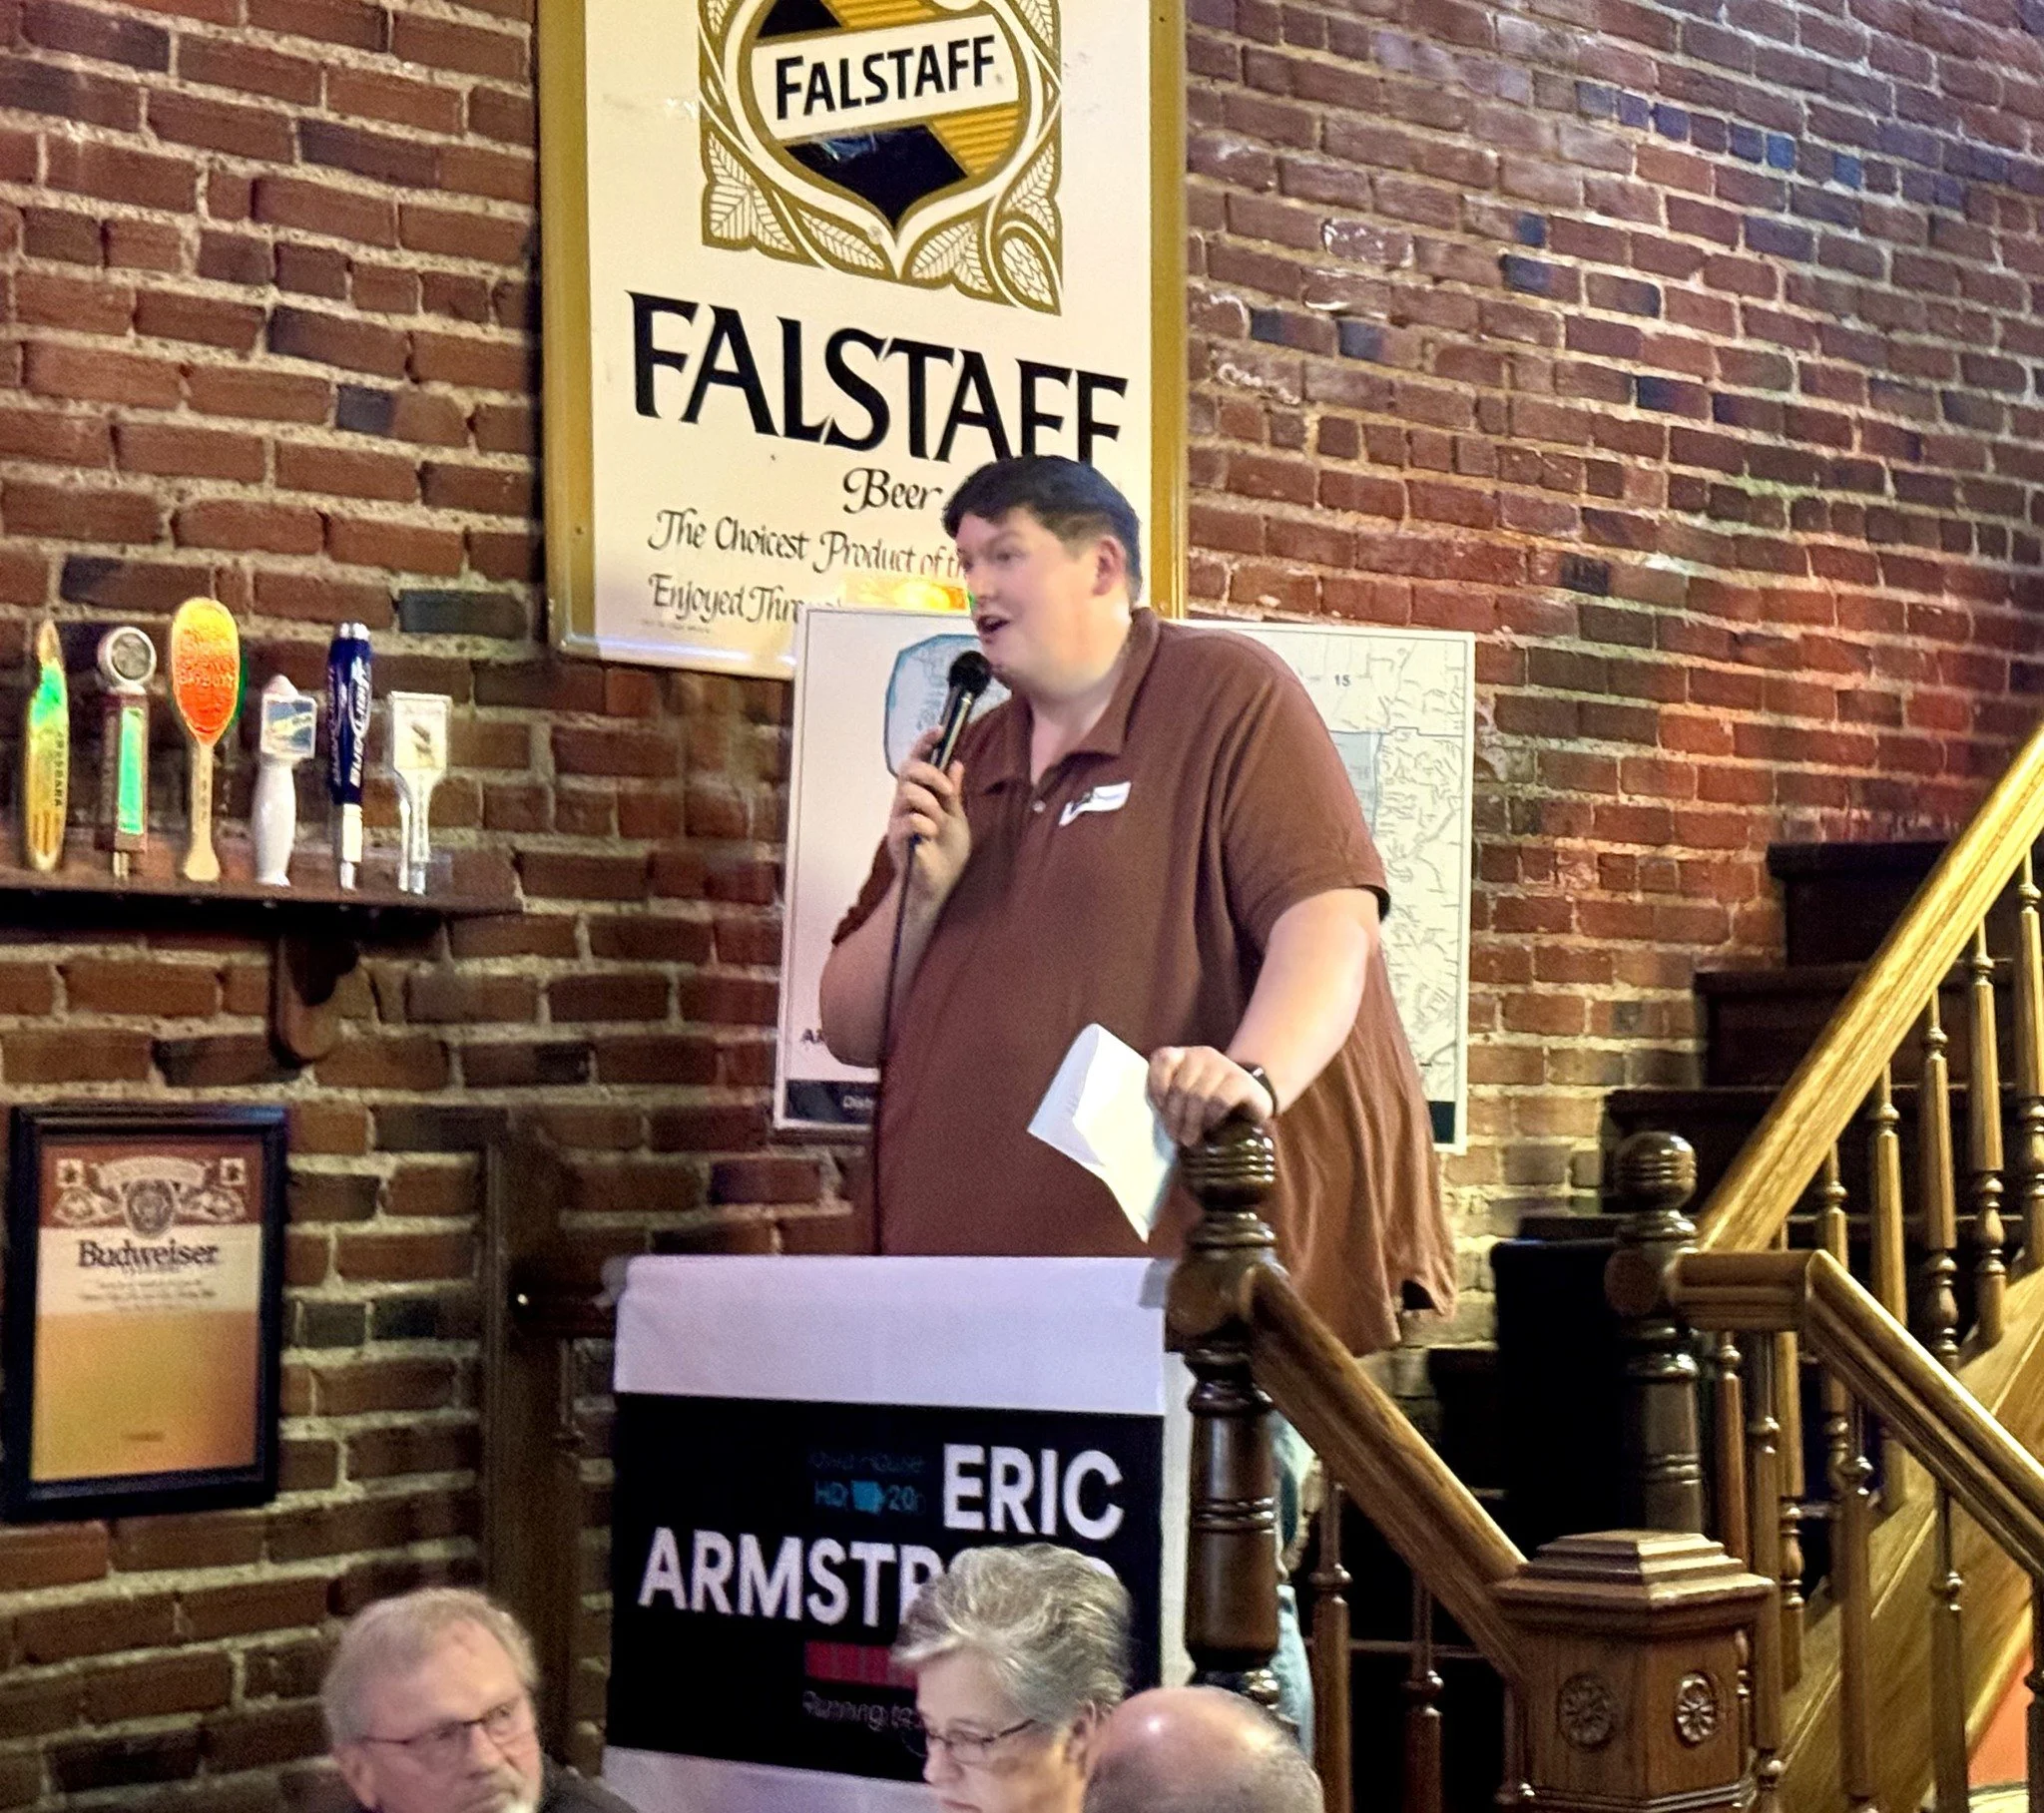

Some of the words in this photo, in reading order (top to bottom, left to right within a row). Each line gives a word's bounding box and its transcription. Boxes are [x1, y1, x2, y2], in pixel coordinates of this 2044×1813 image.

[775, 35, 995, 120] FALSTAFF
[626, 290, 1129, 466] FALSTAFF
[842, 467, 943, 514] Beer
[647, 508, 707, 550] The
[715, 516, 809, 560] Choicest
[812, 530, 916, 574] Product
[920, 546, 947, 577] of
[648, 573, 746, 624] Enjoyed
[1333, 674, 1351, 687] 15
[78, 1237, 219, 1267] Budweiser
[943, 1443, 1125, 1540] ERIC
